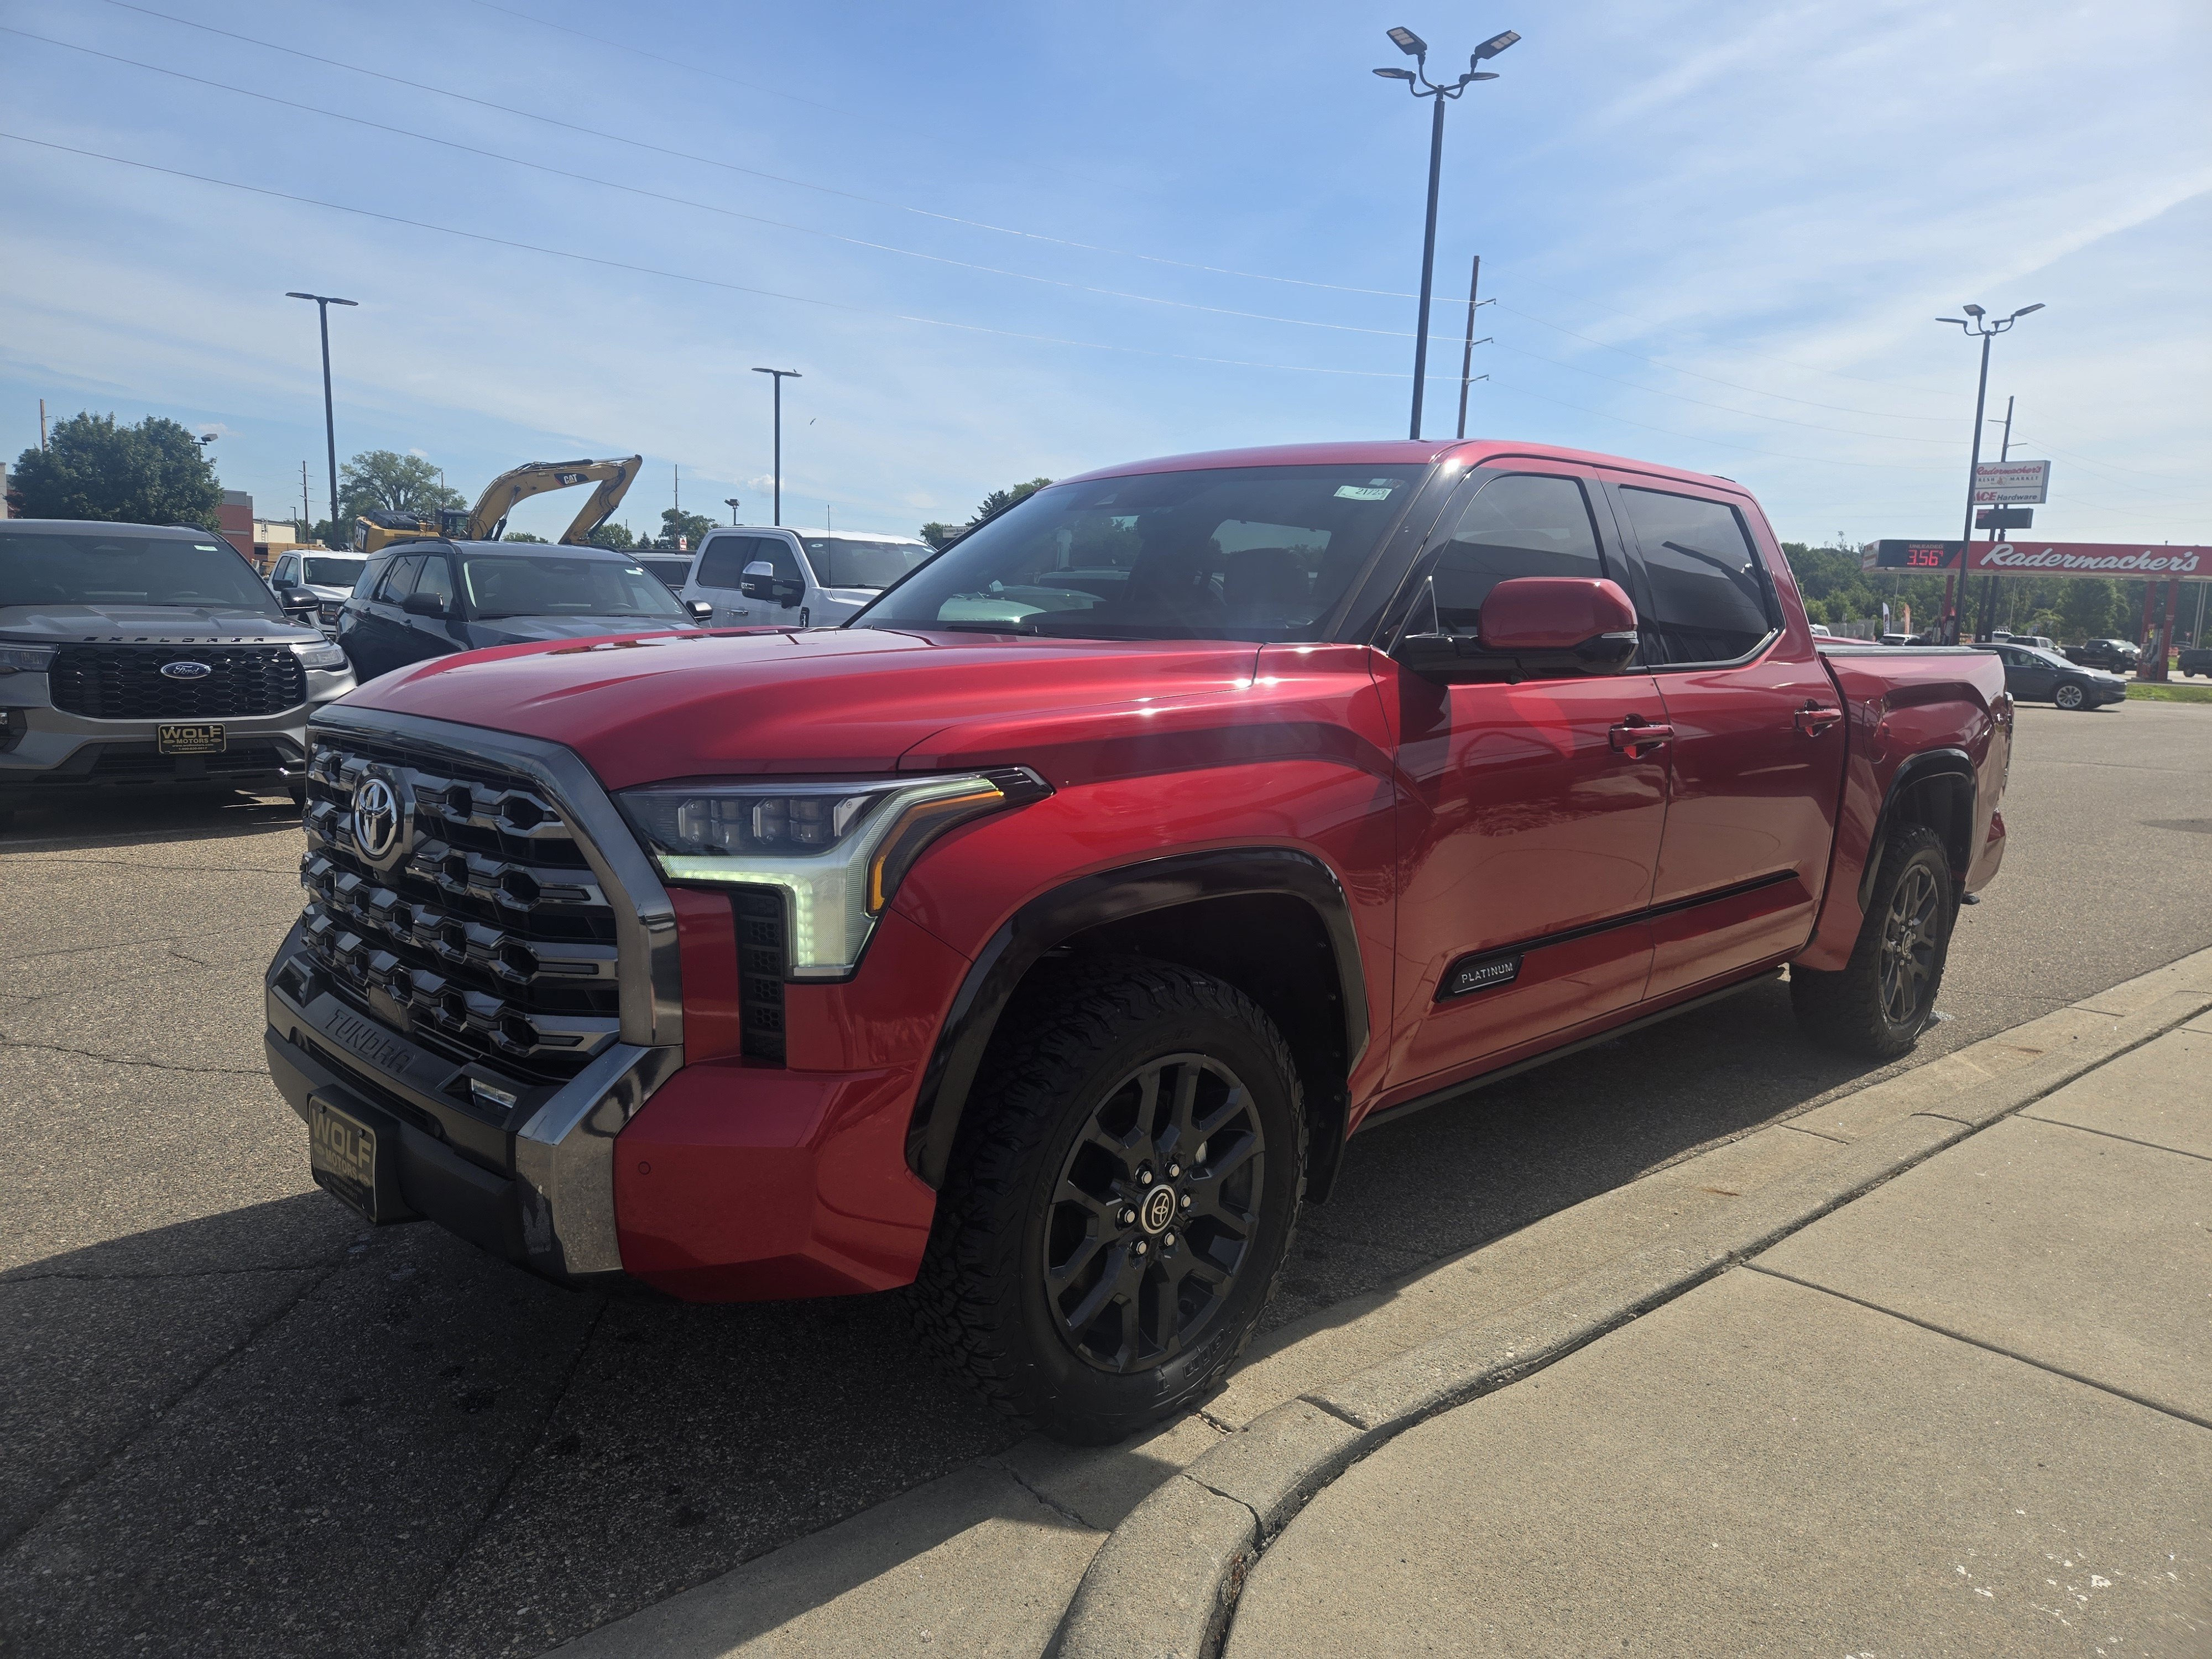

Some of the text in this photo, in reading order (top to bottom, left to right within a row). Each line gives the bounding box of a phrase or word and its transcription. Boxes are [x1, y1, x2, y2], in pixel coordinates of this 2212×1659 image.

[564, 473, 577, 484] CAT
[1980, 543, 2200, 571] Radermacher's
[173, 665, 200, 675] Ford
[161, 728, 221, 739] WOLF
[1462, 962, 1513, 983] PLATINUM
[325, 1009, 416, 1074] TUNDRA
[311, 1108, 372, 1168] WOLF
[325, 1147, 357, 1181] MOTORS
